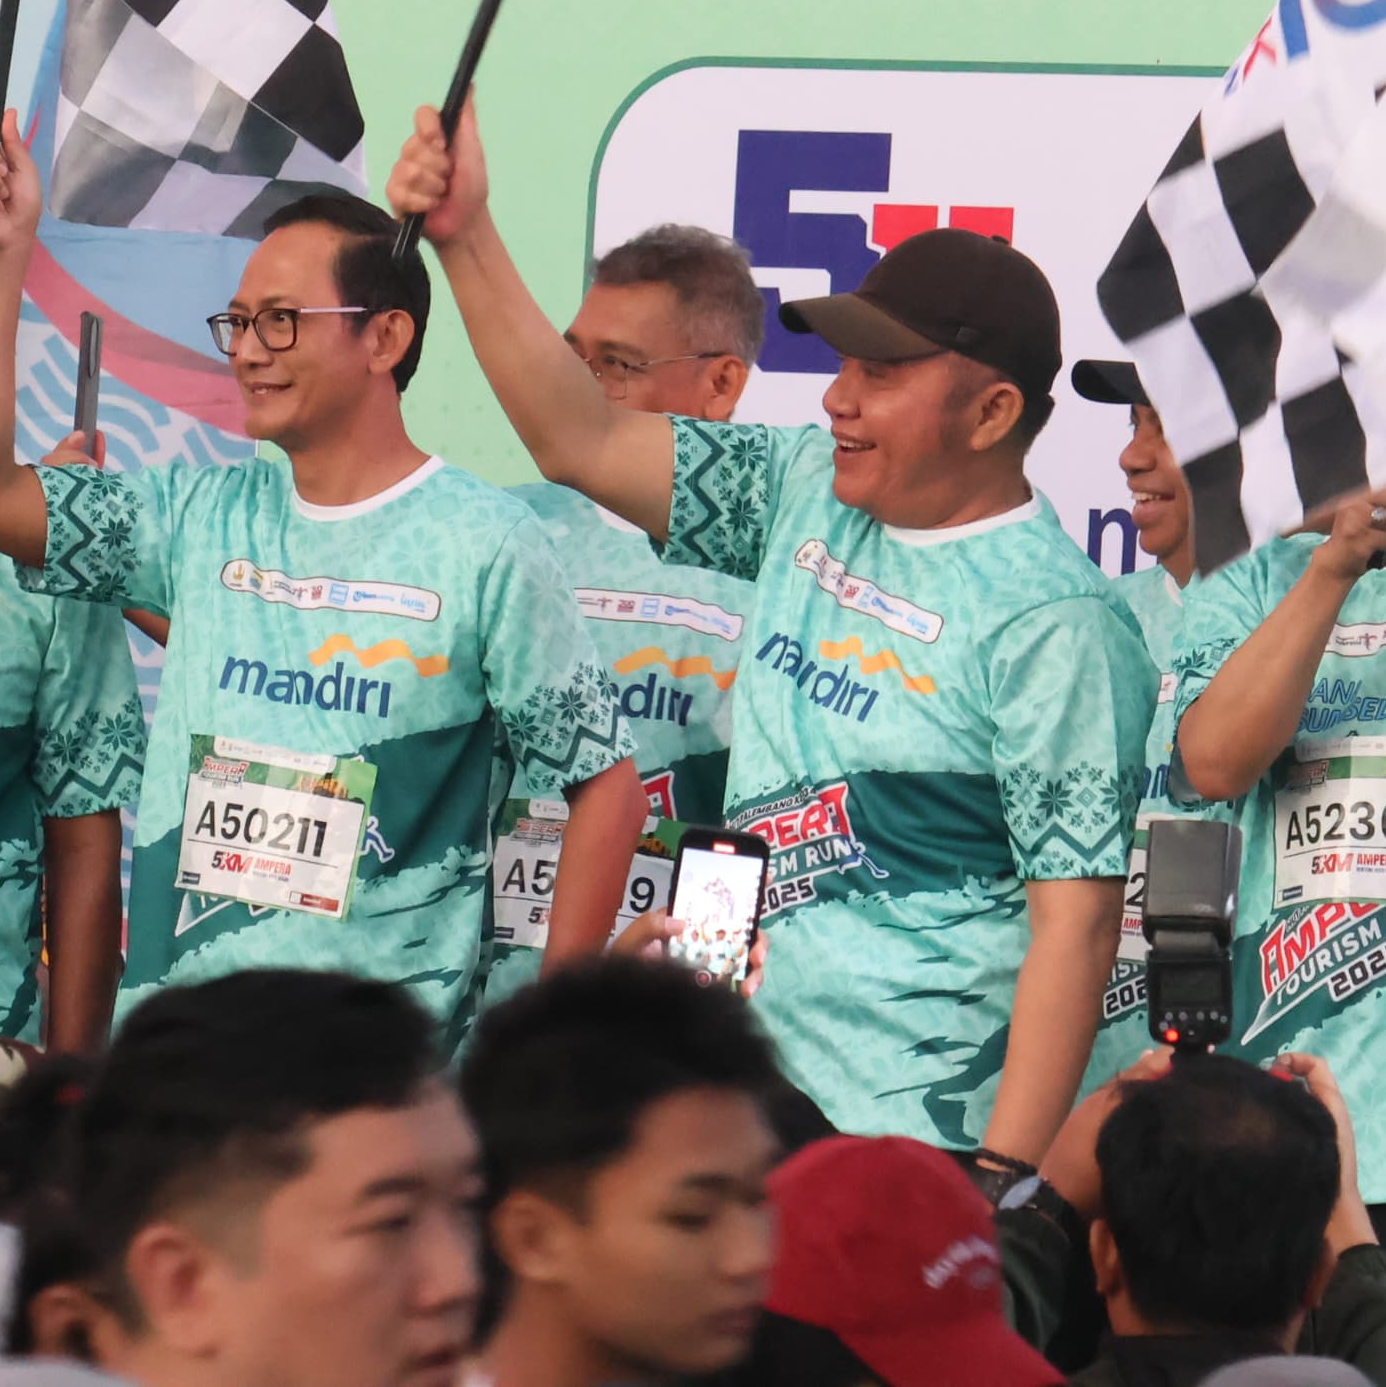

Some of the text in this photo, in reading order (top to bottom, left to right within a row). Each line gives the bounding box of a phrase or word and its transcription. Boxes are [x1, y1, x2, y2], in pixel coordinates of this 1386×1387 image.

[218, 660, 392, 719] mandiri
[194, 800, 328, 858] A50211
[805, 838, 852, 870] RUN
[254, 857, 293, 876] AMPERA
[1276, 917, 1383, 1006] TOURISM
